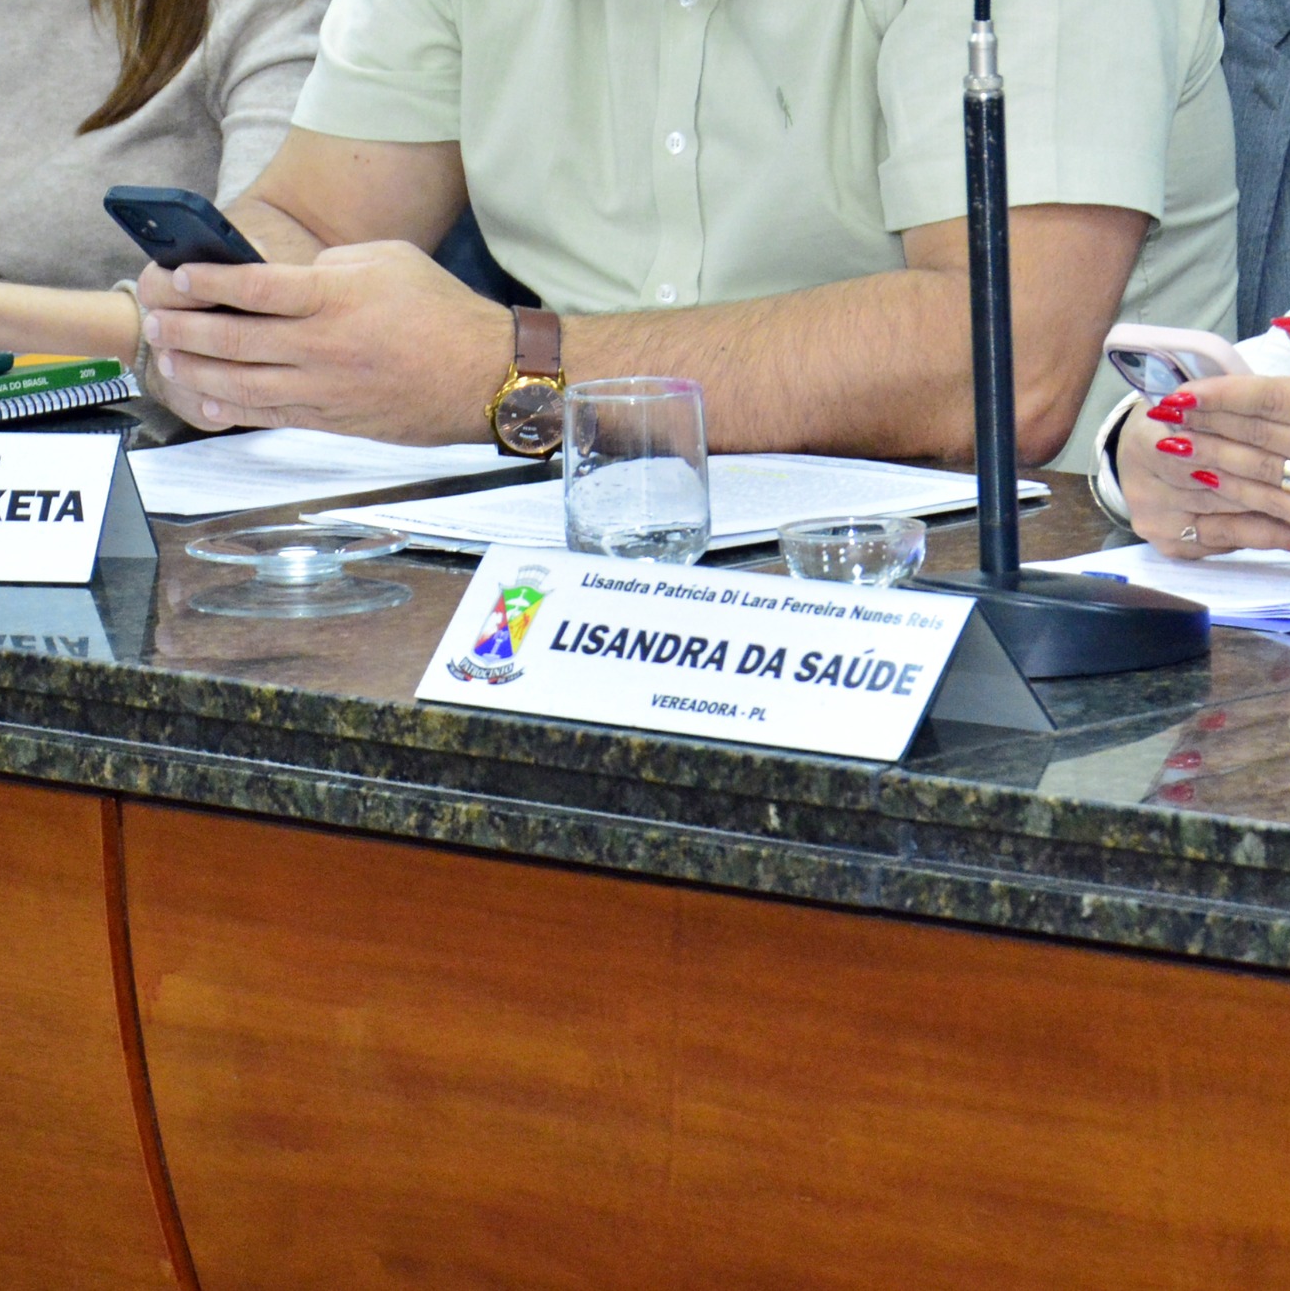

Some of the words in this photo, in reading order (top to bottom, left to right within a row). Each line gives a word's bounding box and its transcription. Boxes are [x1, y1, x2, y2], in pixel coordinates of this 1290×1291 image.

[9, 382, 21, 391] DO
[23, 377, 49, 387] BRASIL
[79, 368, 96, 379] 2019
[581, 572, 650, 594] Lisandra
[653, 581, 717, 602] Patrícia
[720, 589, 740, 605] Di
[741, 591, 777, 610] Lara
[781, 597, 846, 618] Ferreira
[849, 605, 903, 625] Nunes
[906, 612, 944, 630] Reis
[549, 620, 729, 671] LISANDRA
[735, 643, 787, 678] DA
[793, 648, 923, 696] SAÚDE
[650, 693, 737, 717] VEREADORA
[749, 707, 766, 721] PL
